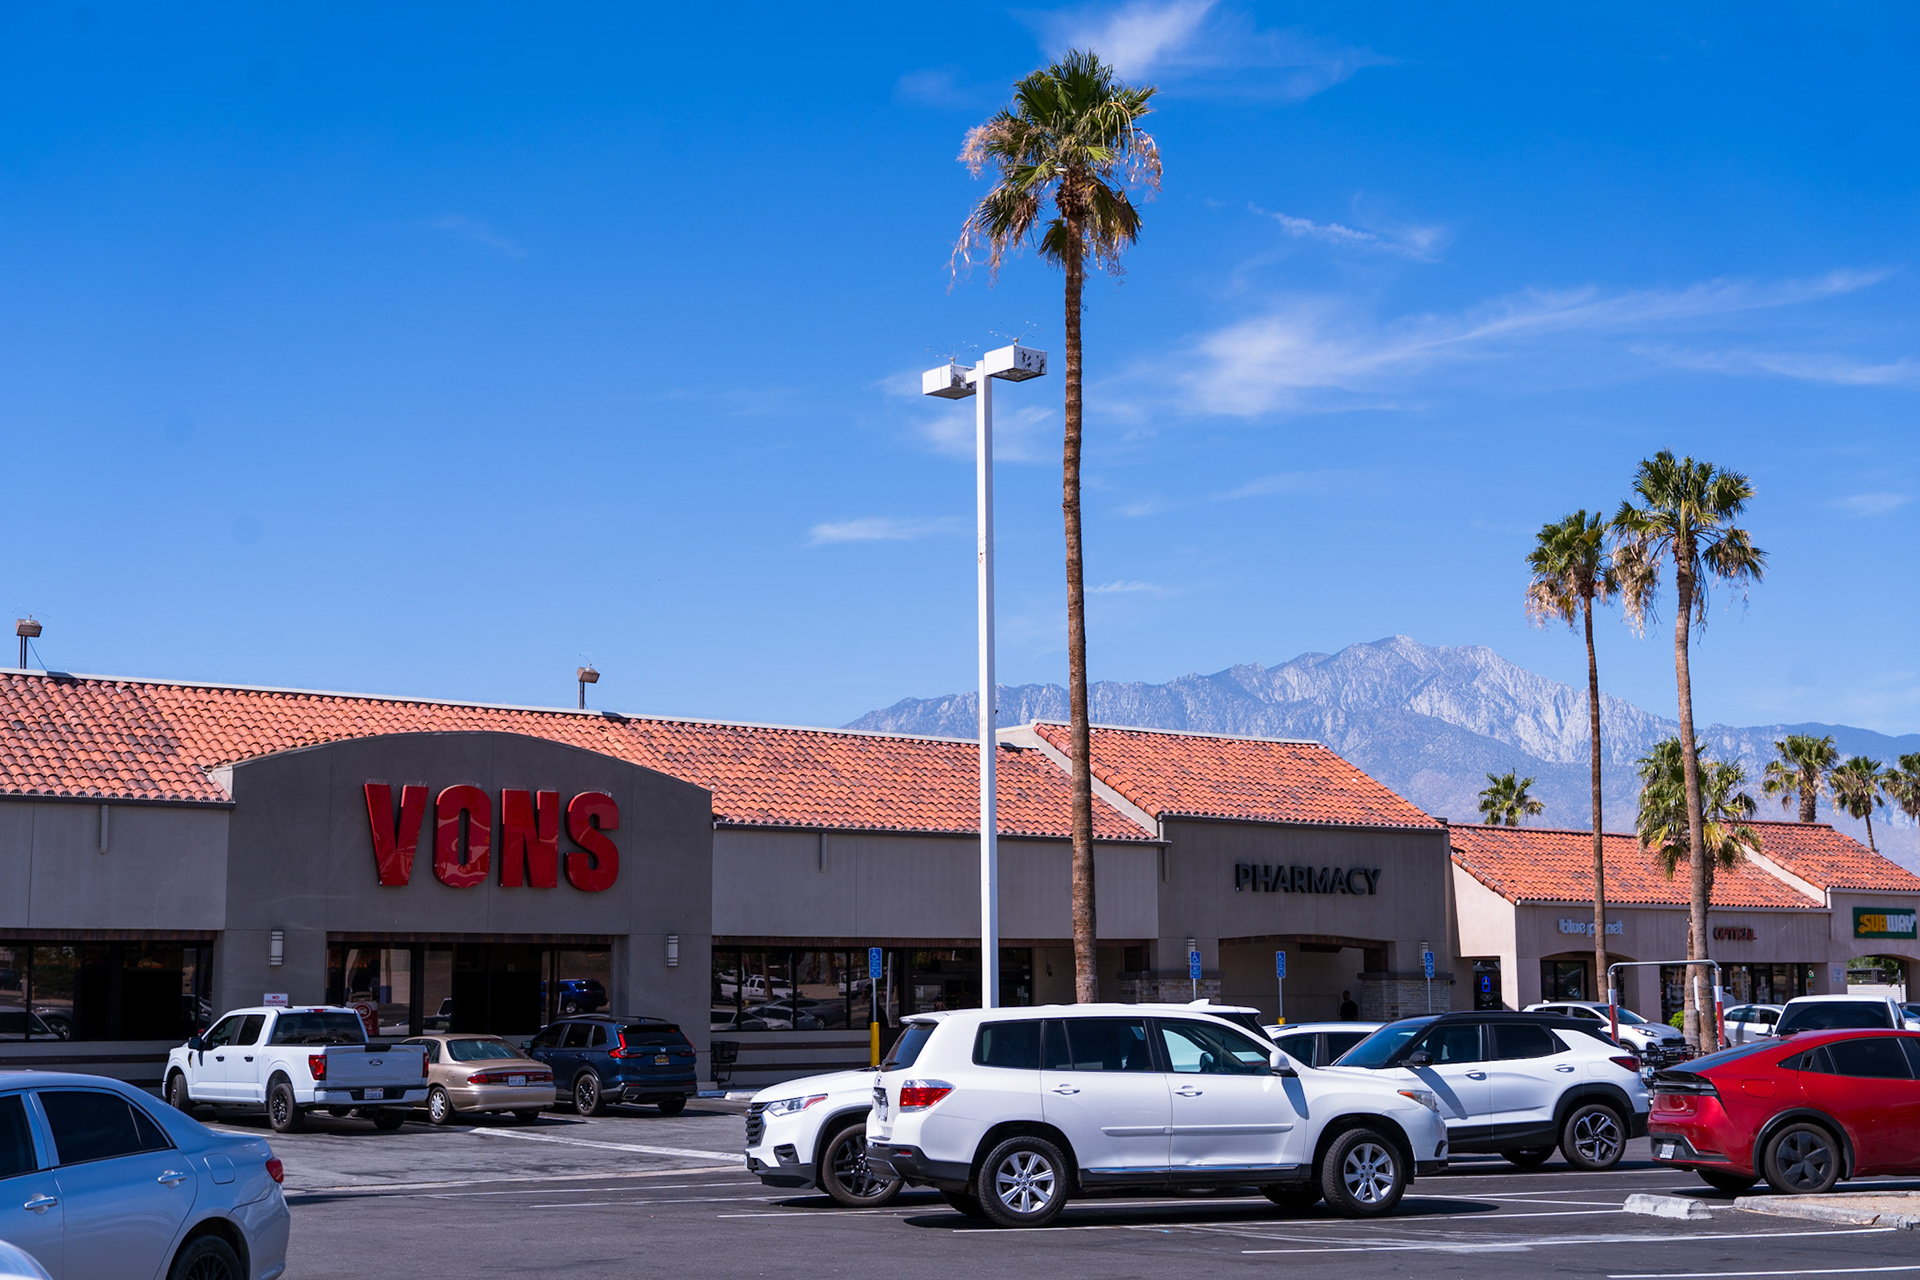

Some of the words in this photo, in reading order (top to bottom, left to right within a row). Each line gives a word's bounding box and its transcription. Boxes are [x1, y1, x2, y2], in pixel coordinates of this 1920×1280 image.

[363, 783, 619, 892] VONS
[1235, 863, 1381, 895] PHARMACY
[1558, 919, 1586, 934] blue
[1586, 920, 1624, 937] pnet
[1858, 913, 1917, 933] SUBWAY
